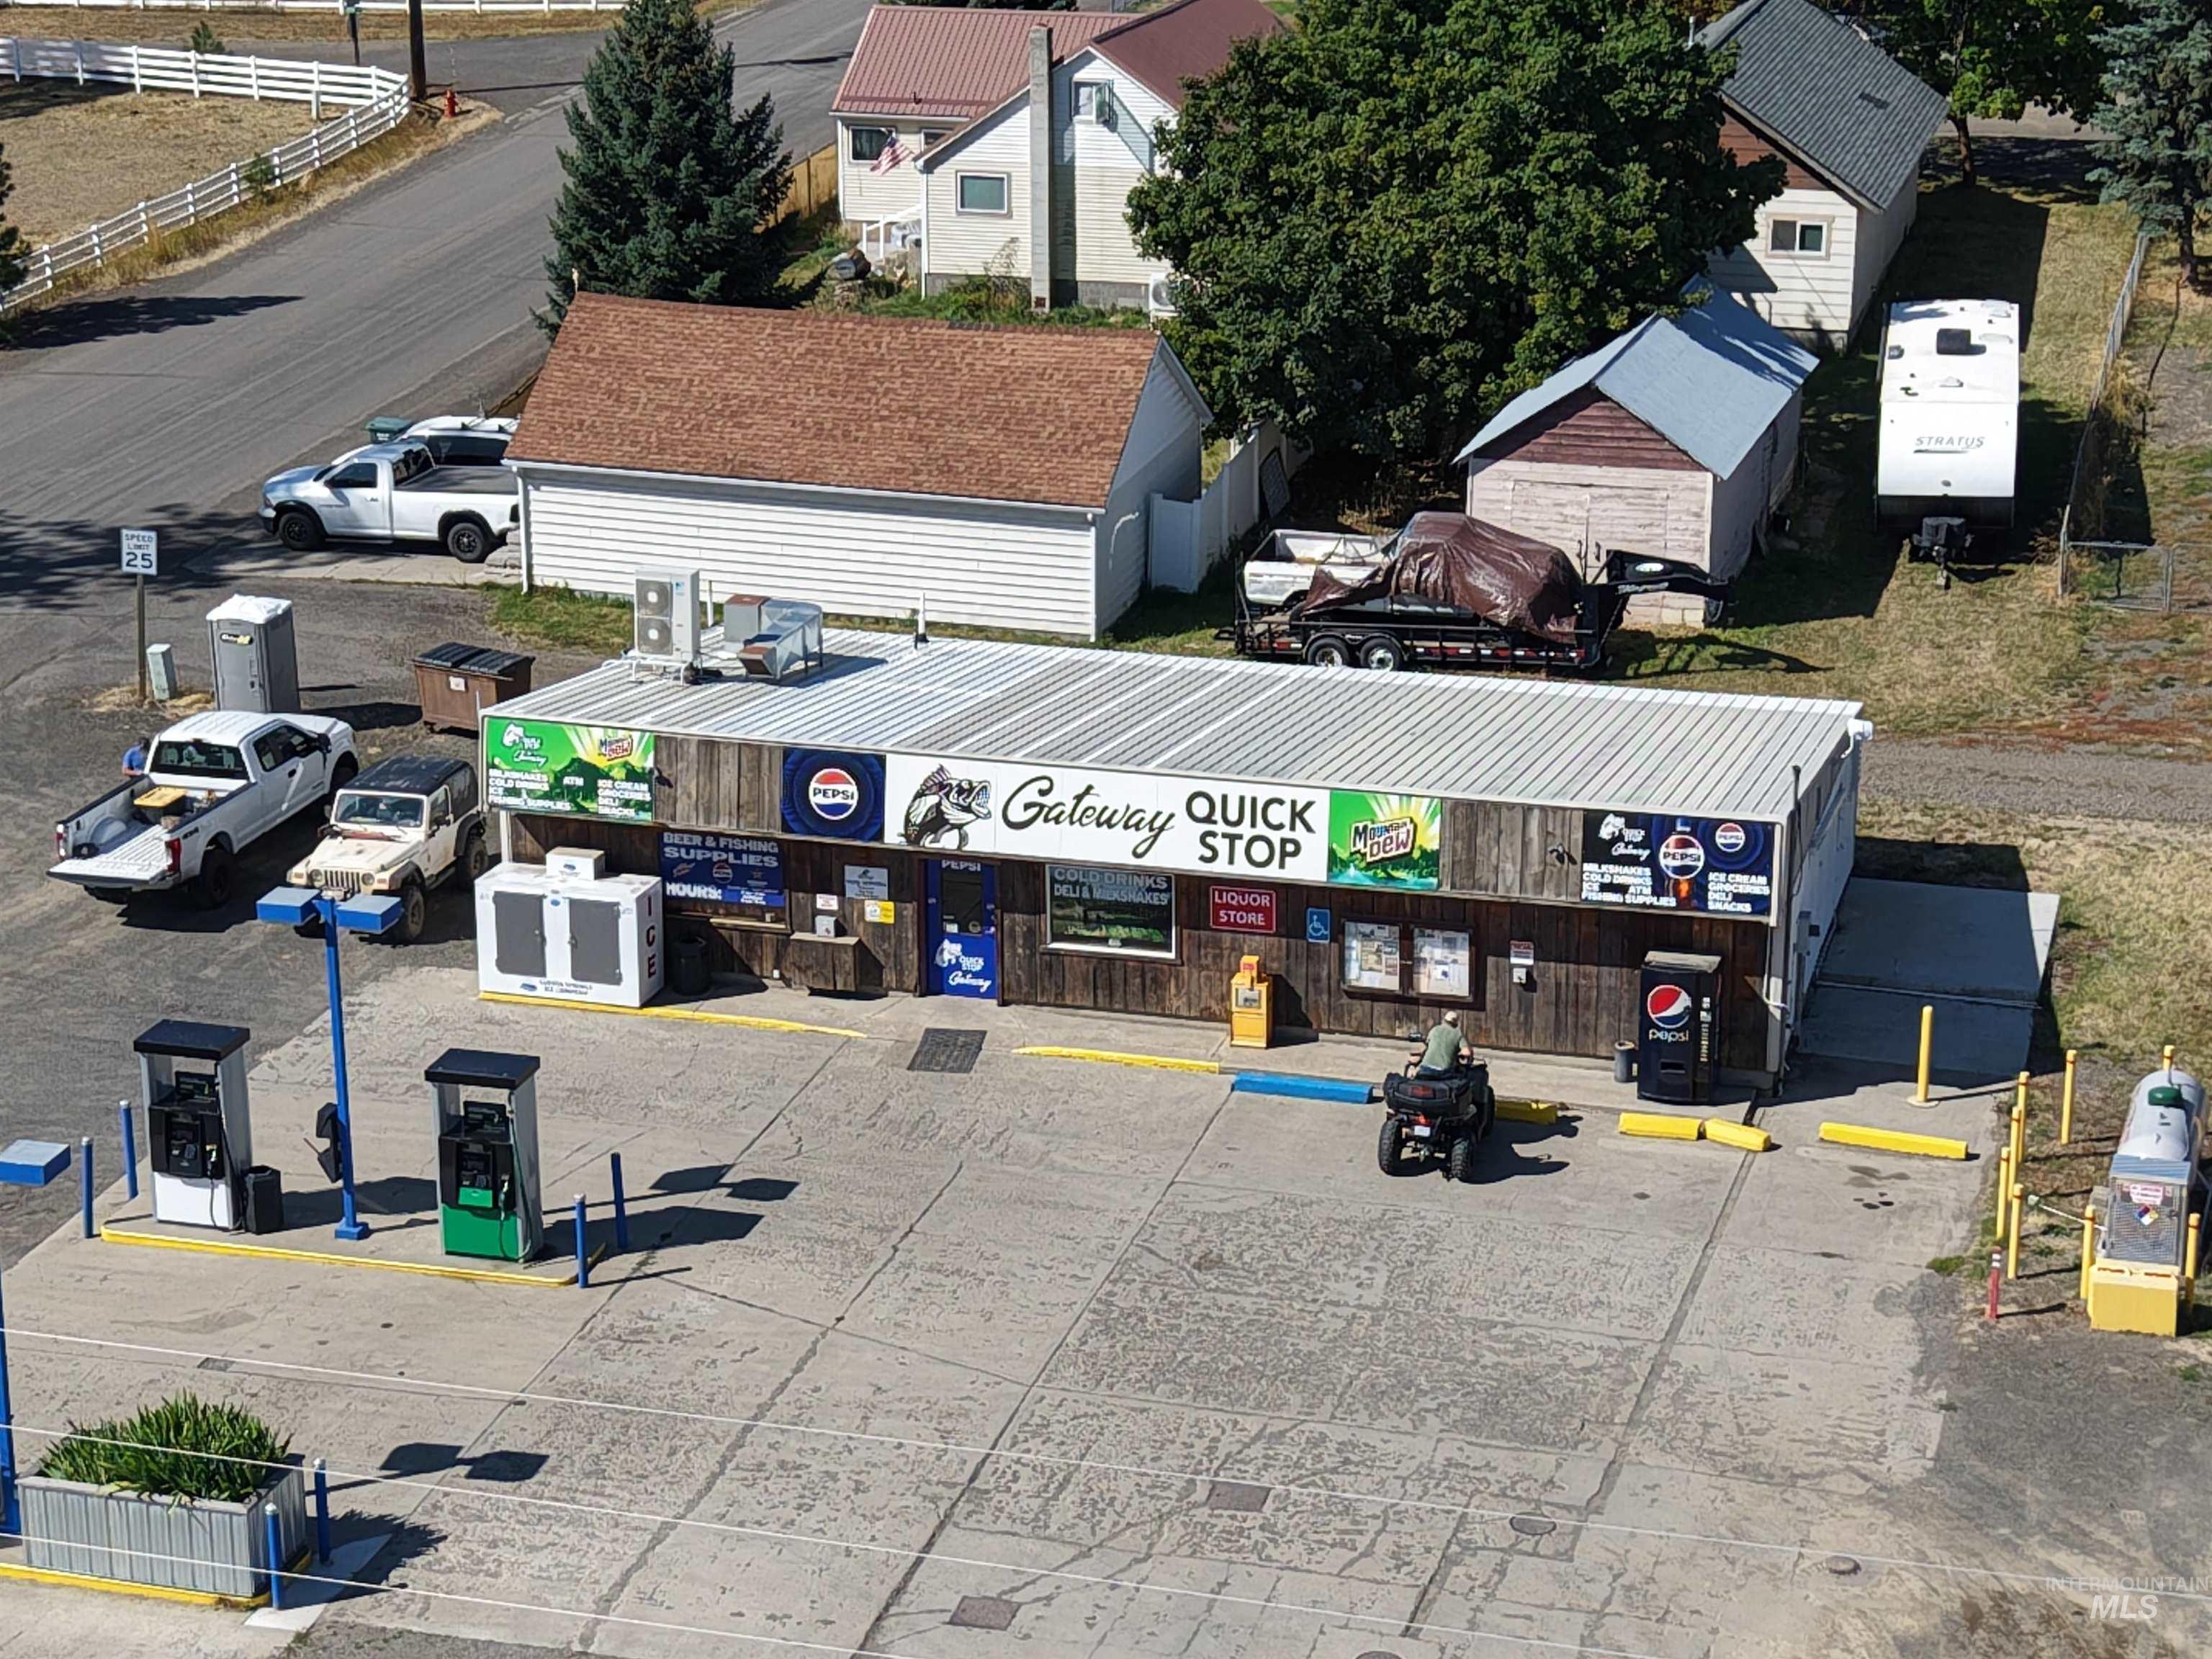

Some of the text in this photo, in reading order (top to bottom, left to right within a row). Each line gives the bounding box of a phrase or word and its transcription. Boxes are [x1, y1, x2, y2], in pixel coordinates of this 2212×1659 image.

[1916, 436, 1986, 448] STRATUS
[125, 552, 153, 569] 25
[813, 787, 855, 801] PEPSI
[1002, 775, 1177, 859] Gateway
[1185, 791, 1317, 835] QUICK
[663, 832, 779, 853] BEER & FISHING
[1197, 830, 1302, 870] STOP
[663, 847, 778, 868] SUPPLIES
[1663, 852, 1701, 862] PEPSI
[941, 860, 982, 872] PEPSI
[1054, 868, 1168, 890] COLD DRINKS
[1583, 872, 1612, 884] COLD
[1707, 872, 1768, 885] ICE CREAM
[665, 882, 723, 900] HOURS:
[1054, 884, 1170, 906] DELI & MILKSHAKES
[1627, 885, 1653, 895] ATM
[1707, 882, 1771, 895] GROCERIES
[1214, 891, 1270, 907] LIQUOR
[1707, 891, 1733, 902] DELI
[1707, 902, 1753, 913] SNACKS
[1219, 910, 1266, 925] STORE
[646, 896, 657, 978] ICE
[1649, 1029, 1690, 1043] pepsi
